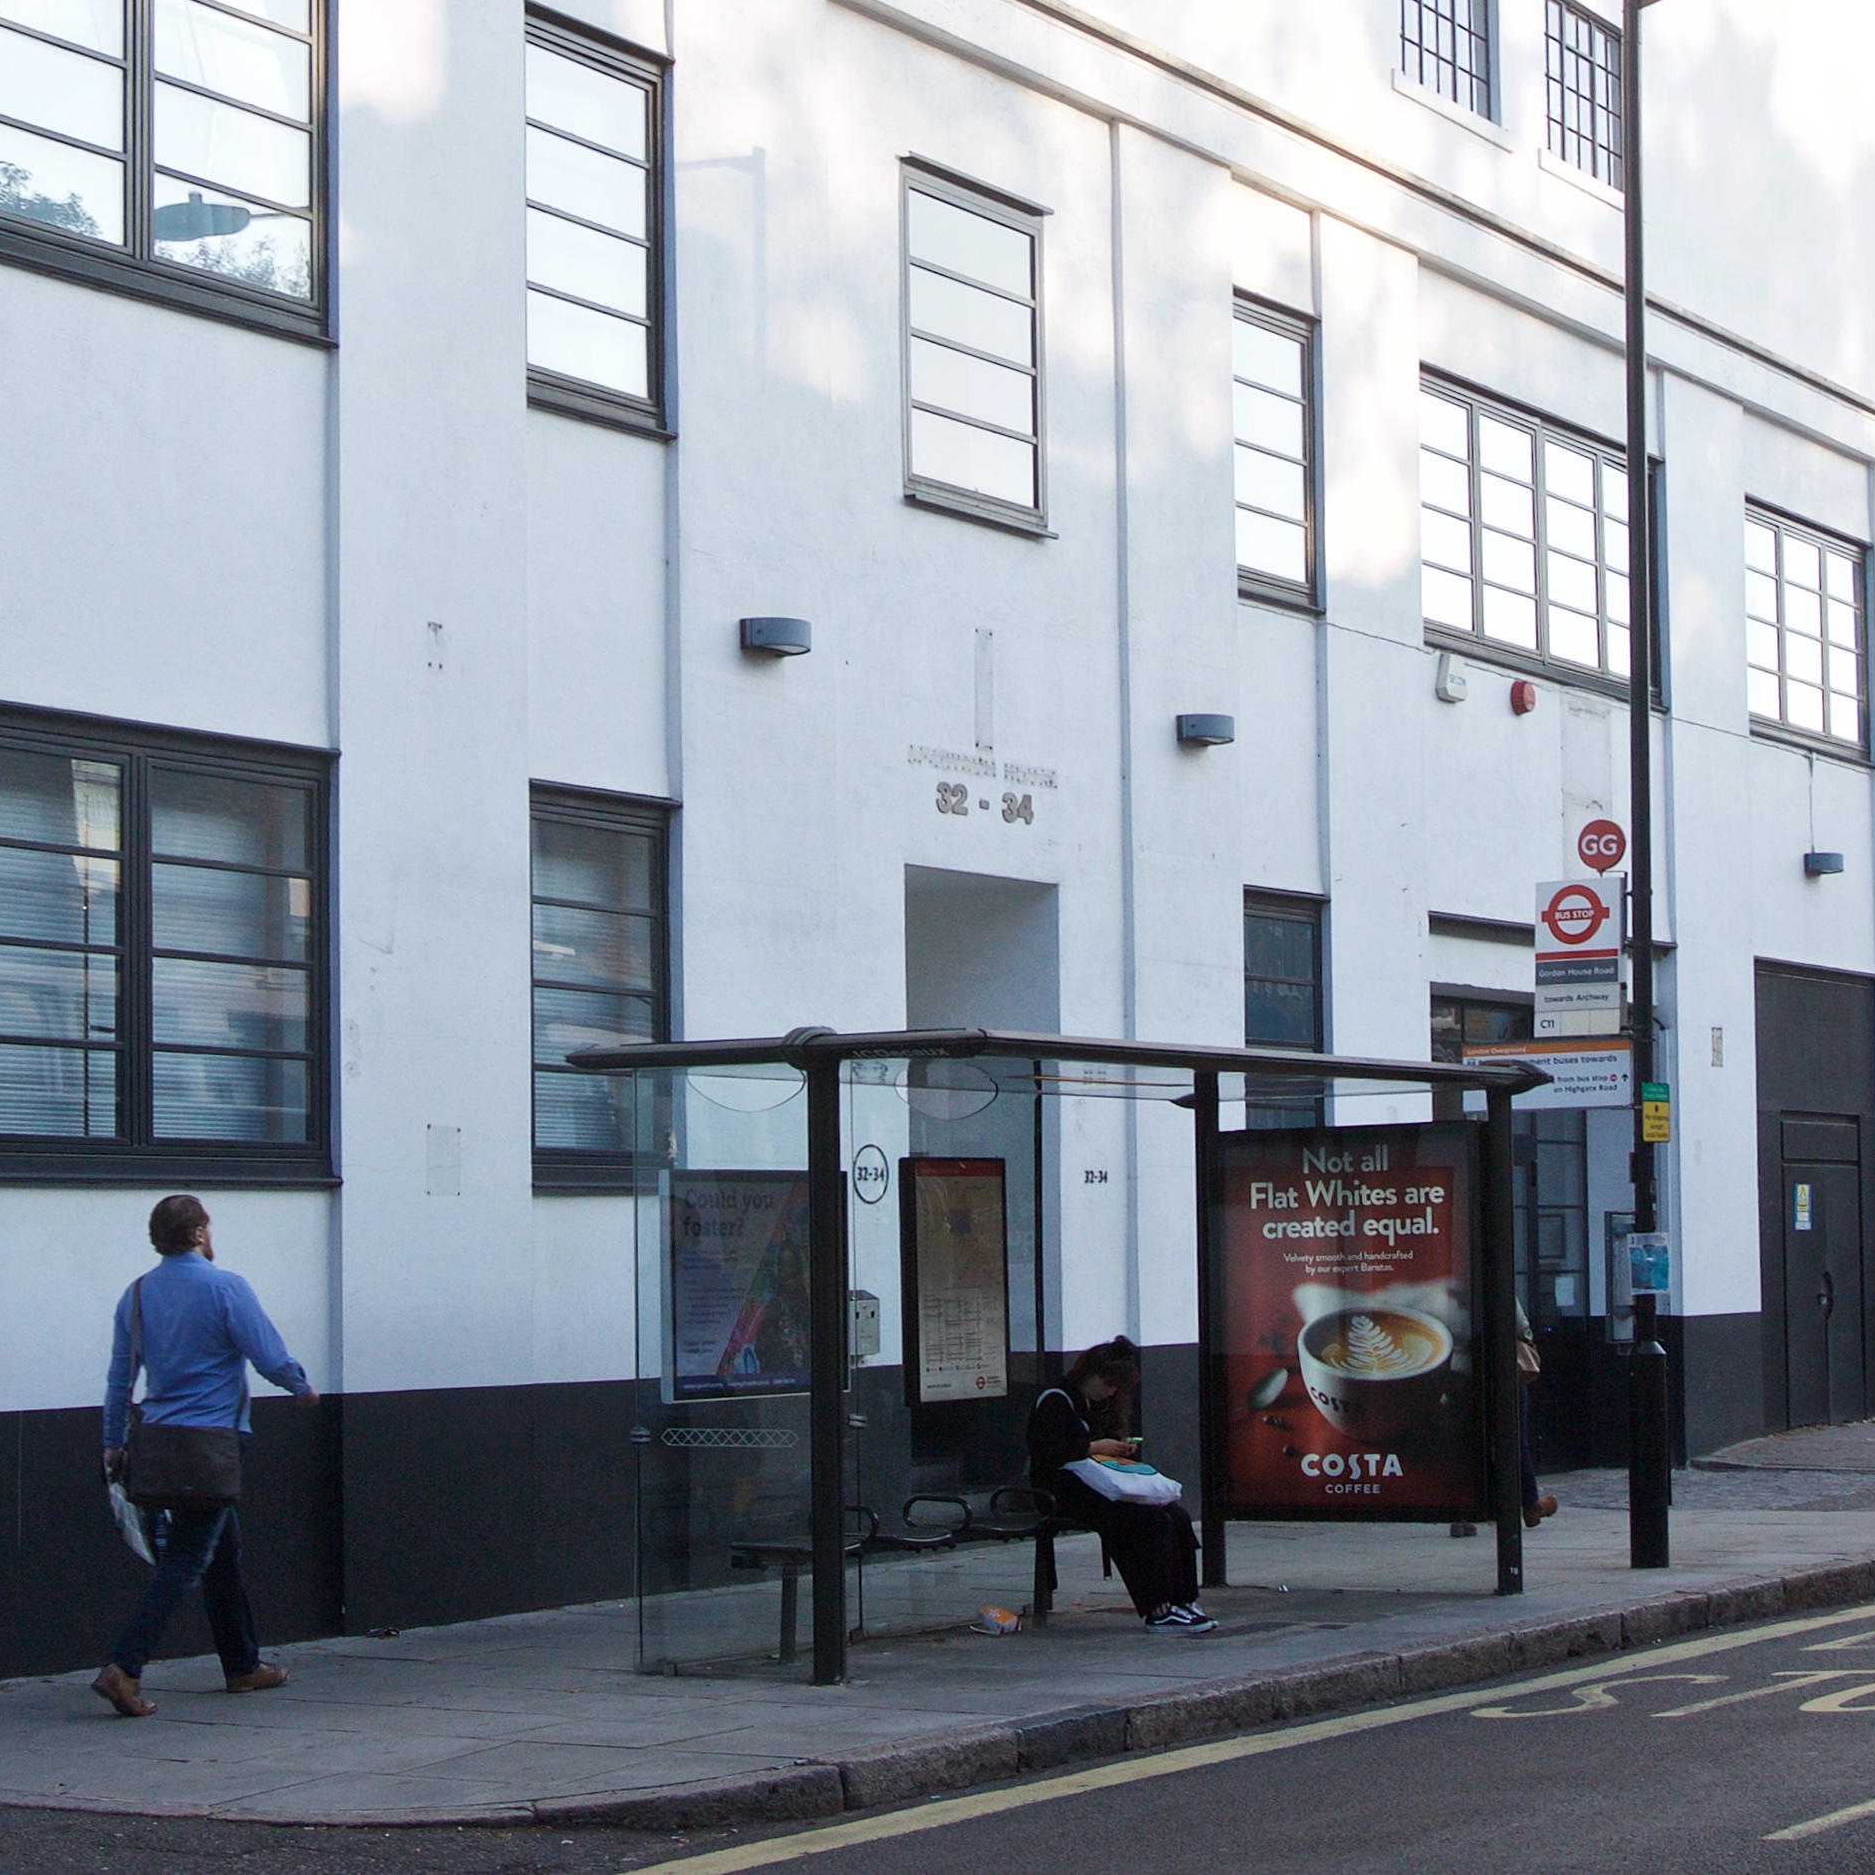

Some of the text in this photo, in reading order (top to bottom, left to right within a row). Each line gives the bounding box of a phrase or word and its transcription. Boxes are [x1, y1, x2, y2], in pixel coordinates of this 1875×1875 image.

[936, 781, 968, 816] 32
[1002, 792, 1034, 825] 34
[1581, 834, 1618, 856] GG
[1555, 909, 1594, 920] BUS STOP
[1538, 966, 1615, 978] Gordon House Road
[1544, 993, 1609, 1004] towards Archway
[1540, 1019, 1555, 1029] C11
[1467, 1046, 1527, 1056] London Overground
[1553, 1055, 1579, 1065] buses
[1581, 1054, 1617, 1064] towards
[1557, 1075, 1574, 1083] from
[1592, 1074, 1608, 1083] stop
[1565, 1085, 1597, 1094] Highgate
[1599, 1083, 1618, 1091] Road
[1302, 1144, 1389, 1174] Not all
[857, 1166, 885, 1182] 32-34
[1084, 1170, 1108, 1184] 32-34
[684, 1187, 776, 1215] Could you
[1250, 1179, 1446, 1210] Flat Whites are
[683, 1215, 745, 1237] foster?
[1262, 1207, 1440, 1247] created equal.
[1283, 1250, 1413, 1264] Velvety smooth and handcrafted
[1305, 1264, 1316, 1276] by
[1332, 1265, 1359, 1275] expert
[1300, 1453, 1404, 1481] COSTA
[1325, 1483, 1381, 1495] COFFEE
